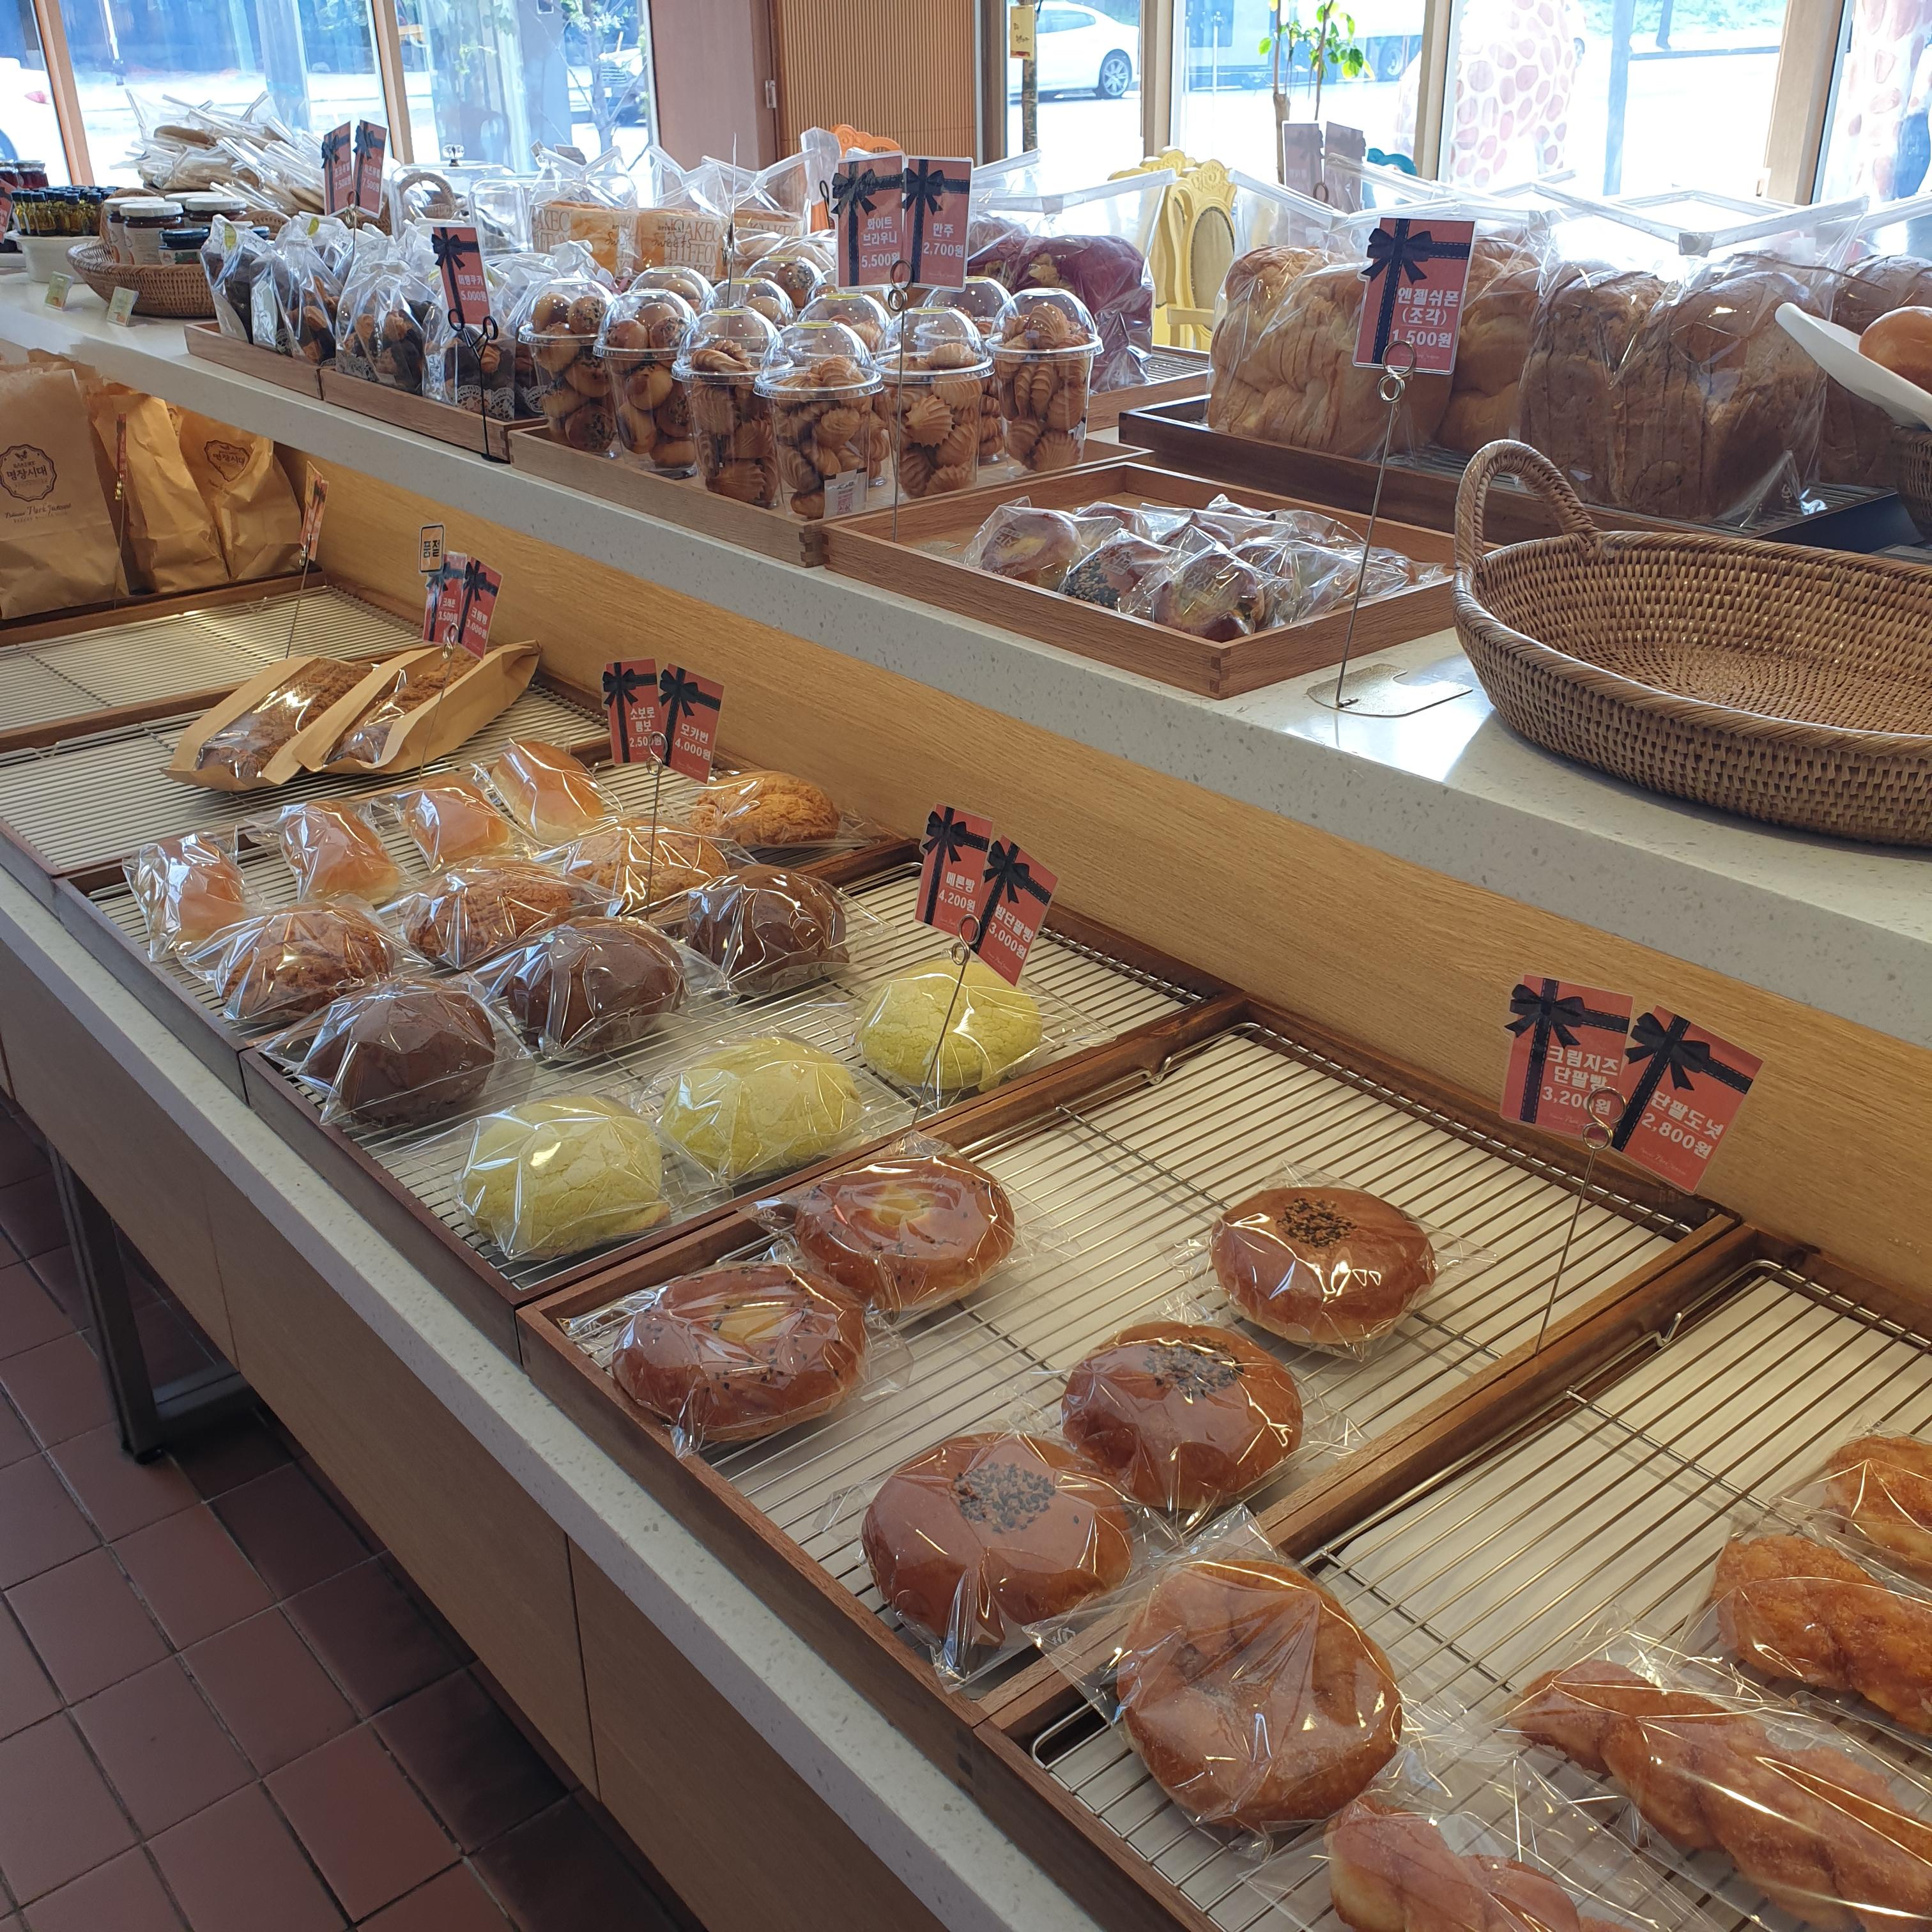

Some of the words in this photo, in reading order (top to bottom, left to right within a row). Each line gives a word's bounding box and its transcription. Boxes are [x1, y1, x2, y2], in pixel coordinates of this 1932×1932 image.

[867, 216, 893, 231] 화이트
[933, 223, 954, 238] 만주
[863, 232, 897, 246] 브라우니
[1397, 288, 1460, 307] 엔젤쉬폰
[1402, 307, 1448, 326] (조각)
[1392, 329, 1452, 348] 1500원
[6, 464, 47, 481] 명장시대
[630, 707, 656, 720] 소보로
[680, 723, 709, 744] 모카번
[946, 871, 976, 893] 메론빵
[939, 889, 976, 913] 4,200원
[994, 903, 1034, 943] 밤단팥빵
[988, 921, 1027, 960] 3,000원
[1546, 1045, 1620, 1077] 크림치즈
[1553, 1065, 1609, 1091] 단팥빵
[1650, 1090, 1724, 1140] 단팥도넛
[1641, 1112, 1713, 1160] 2,800원
